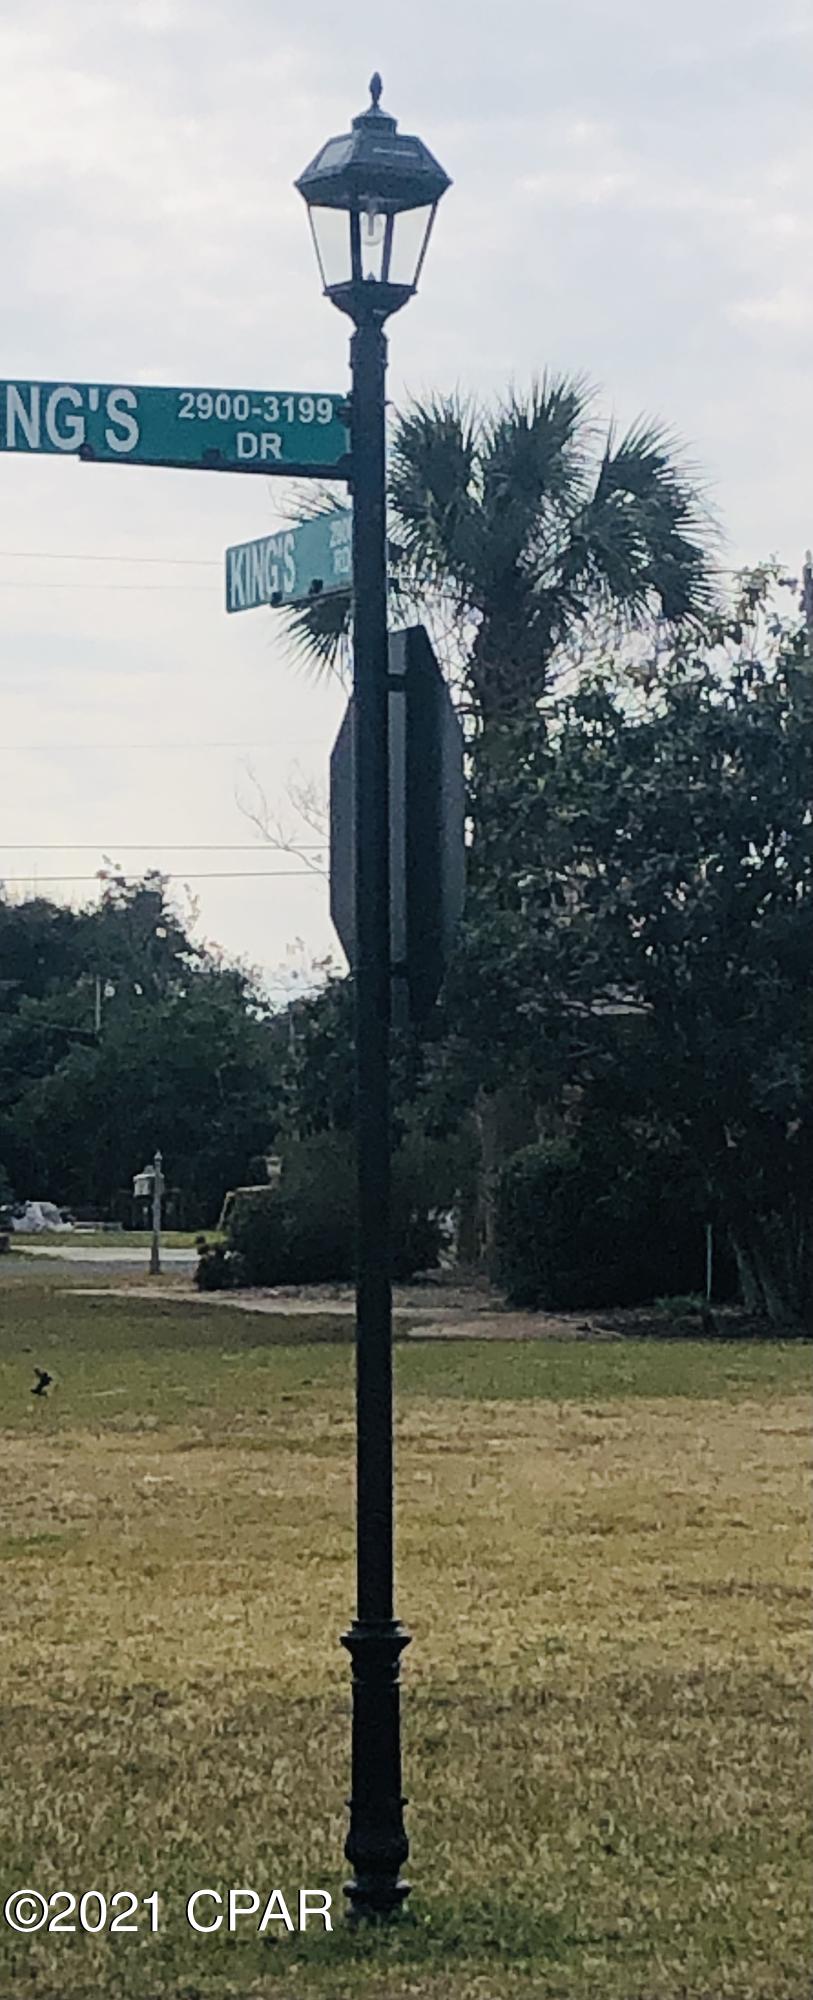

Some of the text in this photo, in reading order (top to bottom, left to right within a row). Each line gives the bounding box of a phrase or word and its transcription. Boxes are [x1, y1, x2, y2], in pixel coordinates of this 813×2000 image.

[178, 392, 333, 424] 2900-3199
[236, 432, 283, 459] DR
[230, 534, 296, 609] KING'S
